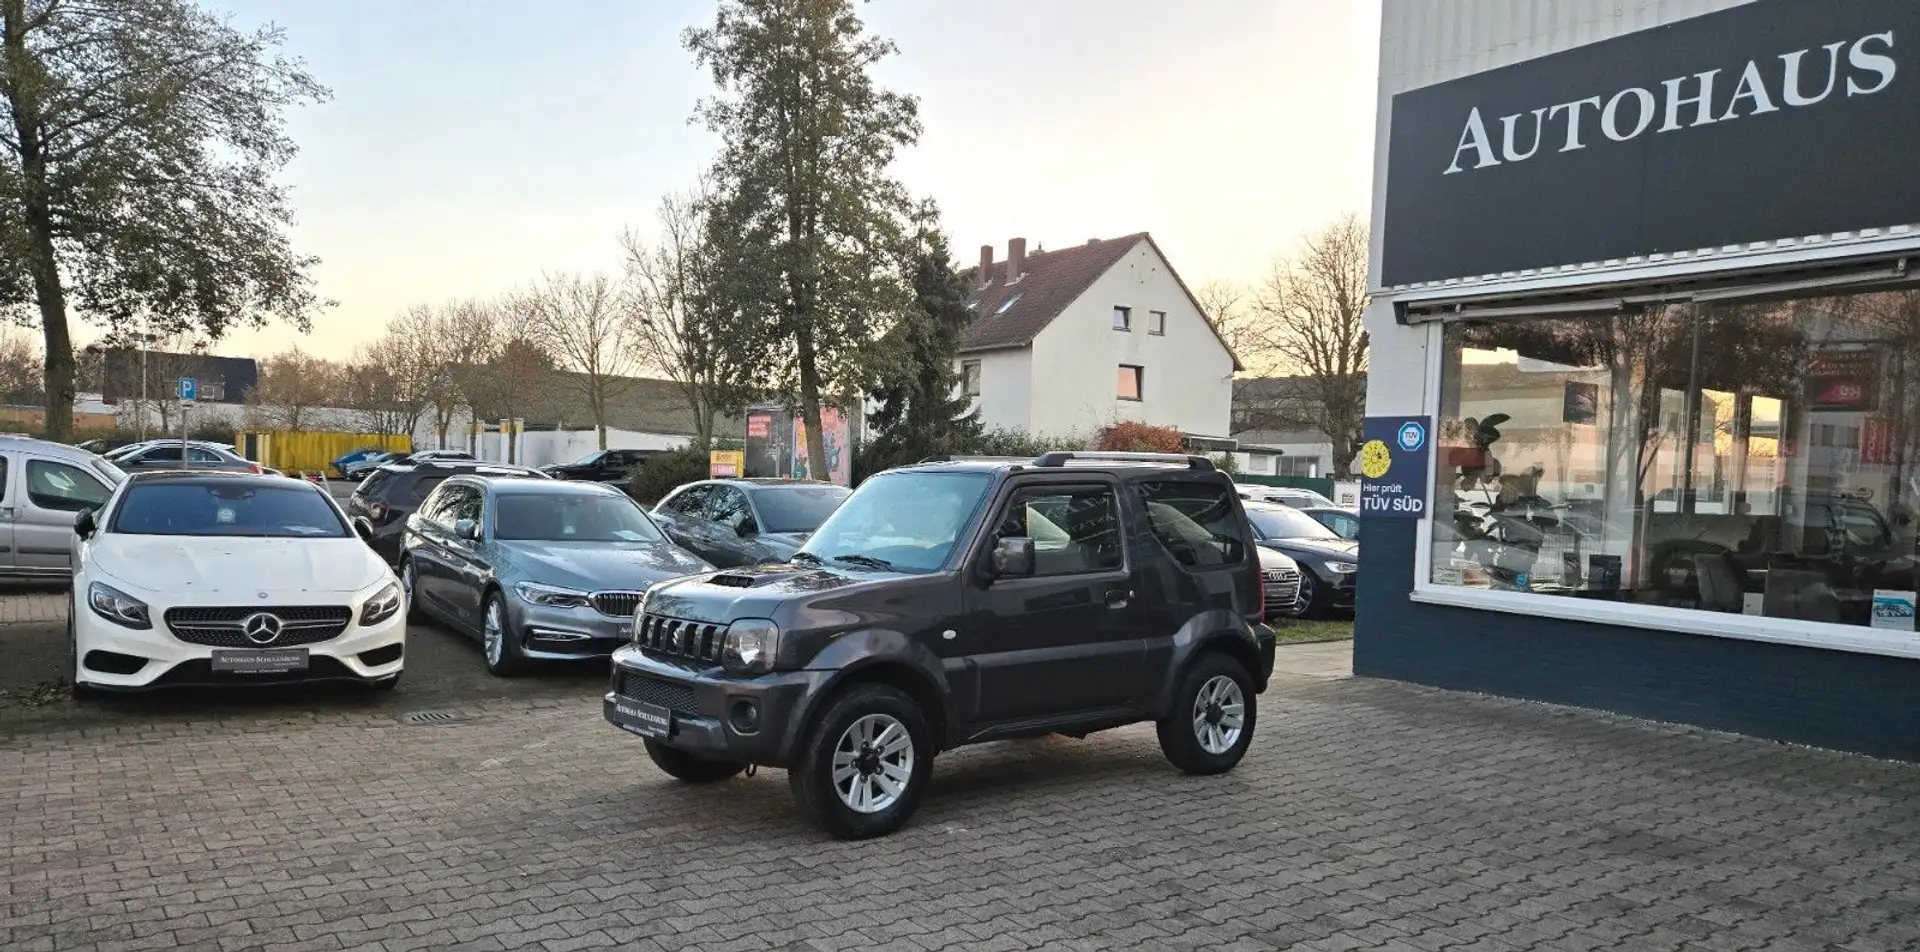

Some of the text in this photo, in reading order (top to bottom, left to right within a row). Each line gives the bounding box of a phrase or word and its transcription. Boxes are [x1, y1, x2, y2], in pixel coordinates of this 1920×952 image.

[1443, 30, 1897, 175] AUTOHAUS
[183, 381, 192, 397] P
[1363, 483, 1402, 494] Hier prüft
[1362, 494, 1423, 512] TÜV SÜD
